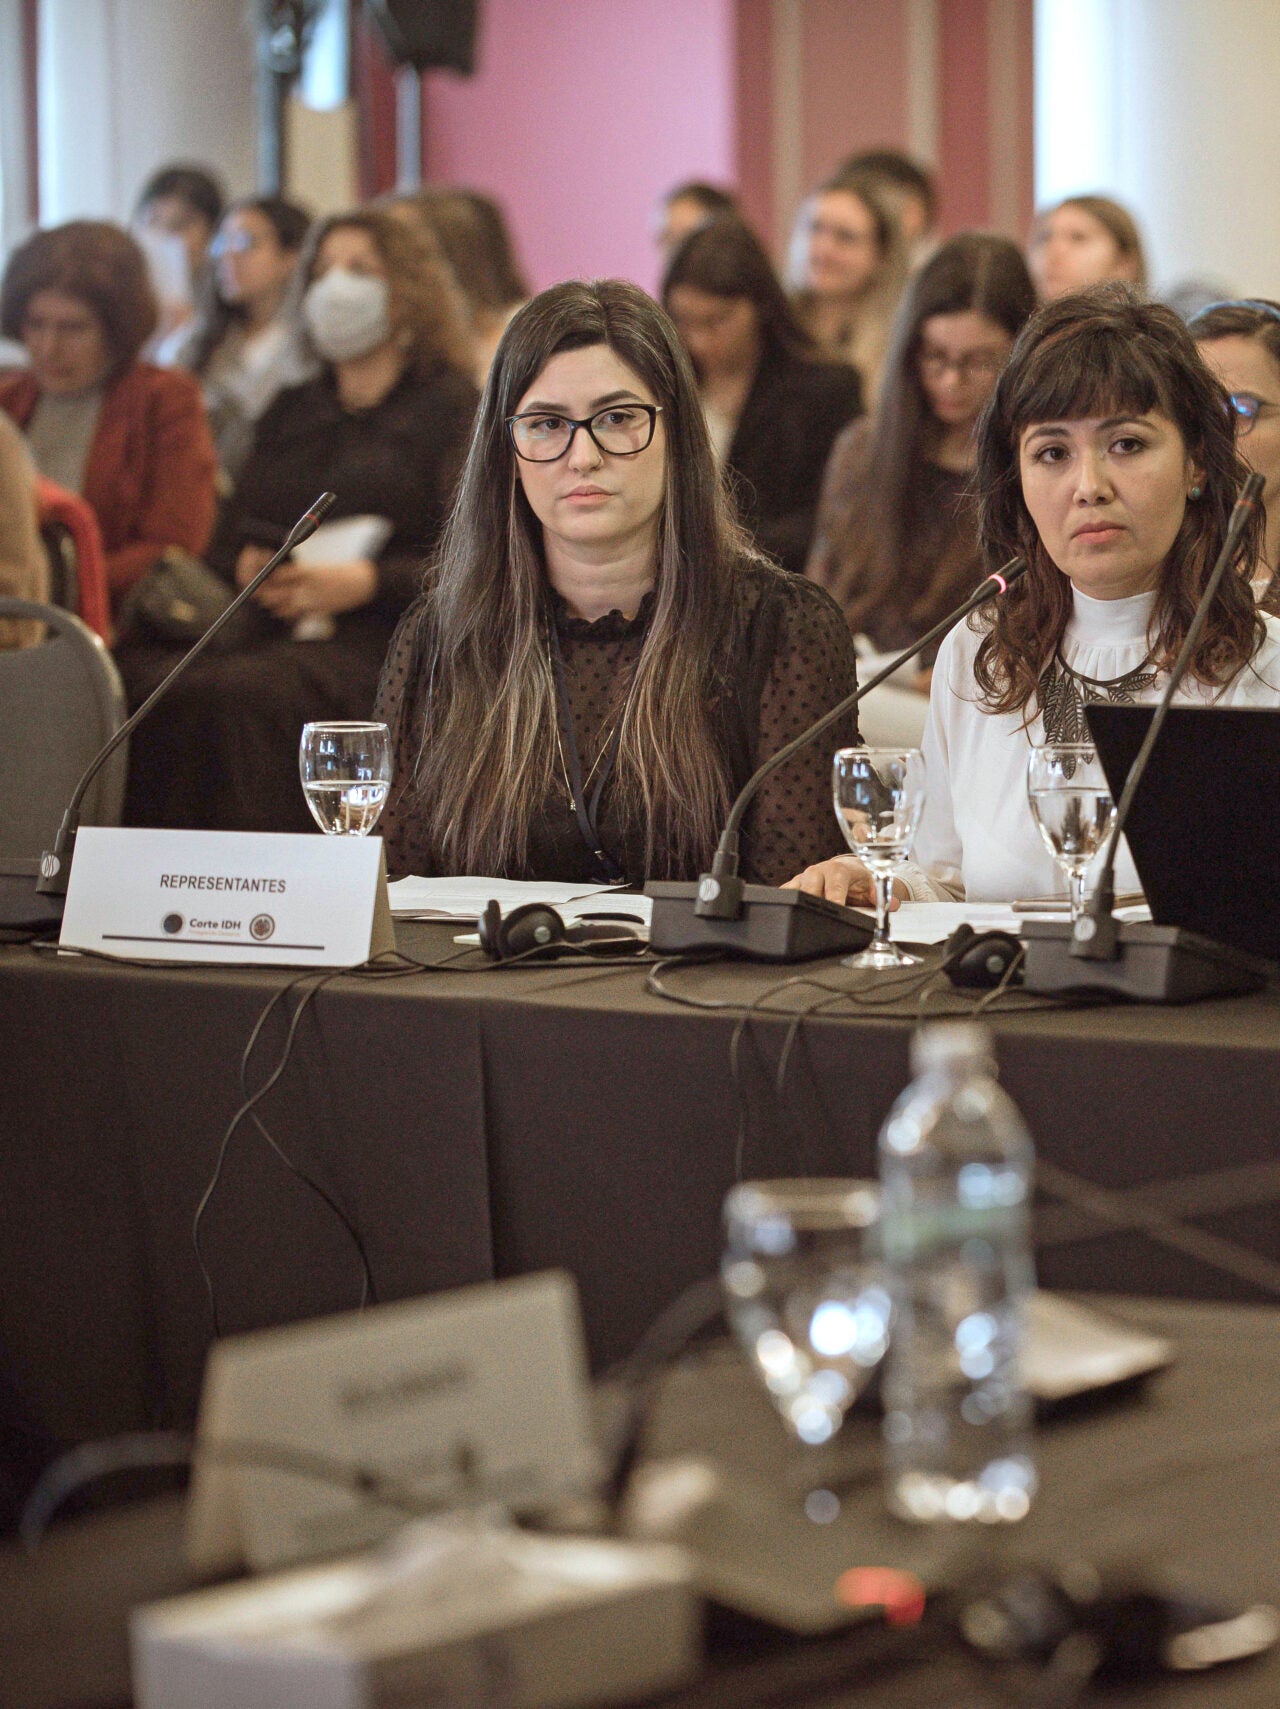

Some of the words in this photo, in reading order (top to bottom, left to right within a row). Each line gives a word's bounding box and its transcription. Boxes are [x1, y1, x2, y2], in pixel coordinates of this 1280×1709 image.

[160, 874, 286, 893] REPRESENTANTES
[189, 918, 219, 929] Corte
[221, 919, 241, 930] IDH
